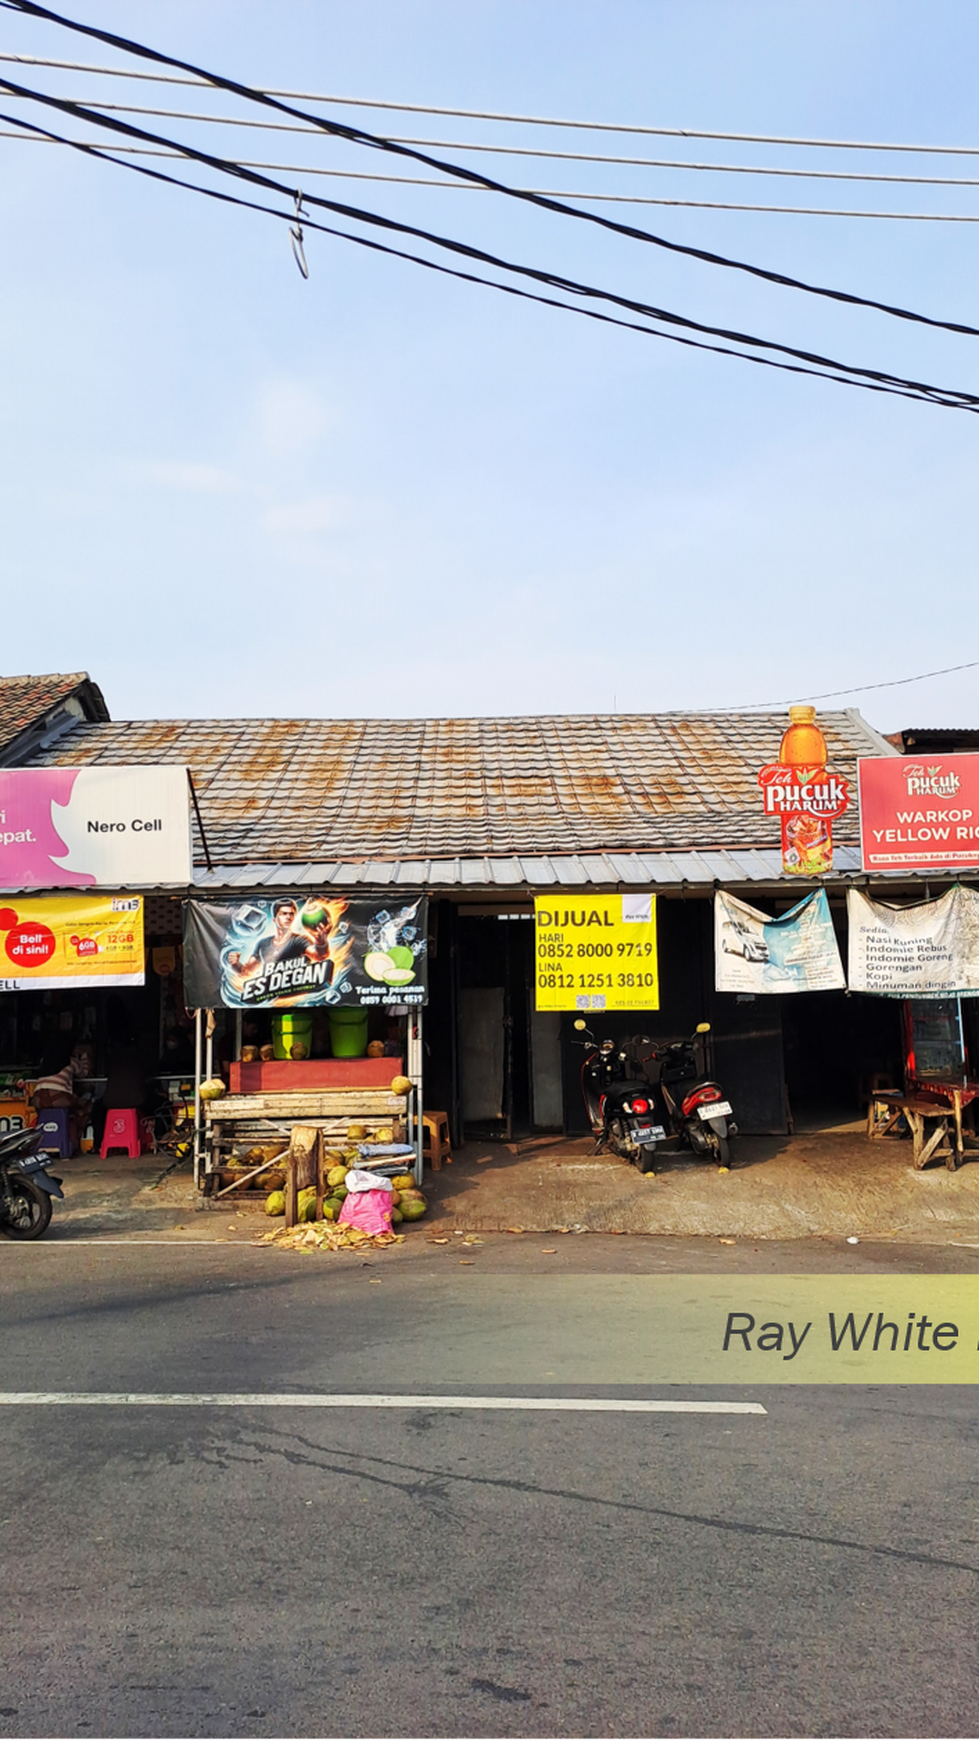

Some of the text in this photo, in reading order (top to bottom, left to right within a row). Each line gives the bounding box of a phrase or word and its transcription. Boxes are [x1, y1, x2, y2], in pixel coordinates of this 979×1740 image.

[761, 766, 792, 785] Teh
[907, 771, 961, 796] pucuk
[766, 778, 846, 812] pucuk
[916, 786, 957, 795] HARUM
[780, 800, 839, 813] HARUM
[896, 809, 973, 824] WARKOP
[87, 819, 162, 834] Nero Cell
[872, 827, 950, 843] YELLOW
[537, 910, 615, 927] DIJUAL
[107, 934, 135, 944] 12GB
[538, 933, 564, 942] HARI
[866, 935, 934, 946] Nasi Kuning
[12, 945, 24, 955] di
[538, 942, 653, 958] 0852 8000 9719
[866, 944, 948, 953] Indomie Rebus
[866, 953, 954, 962] Indomie Goreng
[264, 957, 308, 977] BAKUL
[538, 963, 563, 972] LINA
[866, 963, 923, 973] Gorengan
[242, 961, 328, 1000] ES DEGAN
[538, 973, 654, 988] 0812 1251 3810
[866, 973, 893, 981] Kopi
[866, 980, 957, 989] Minuman dingin
